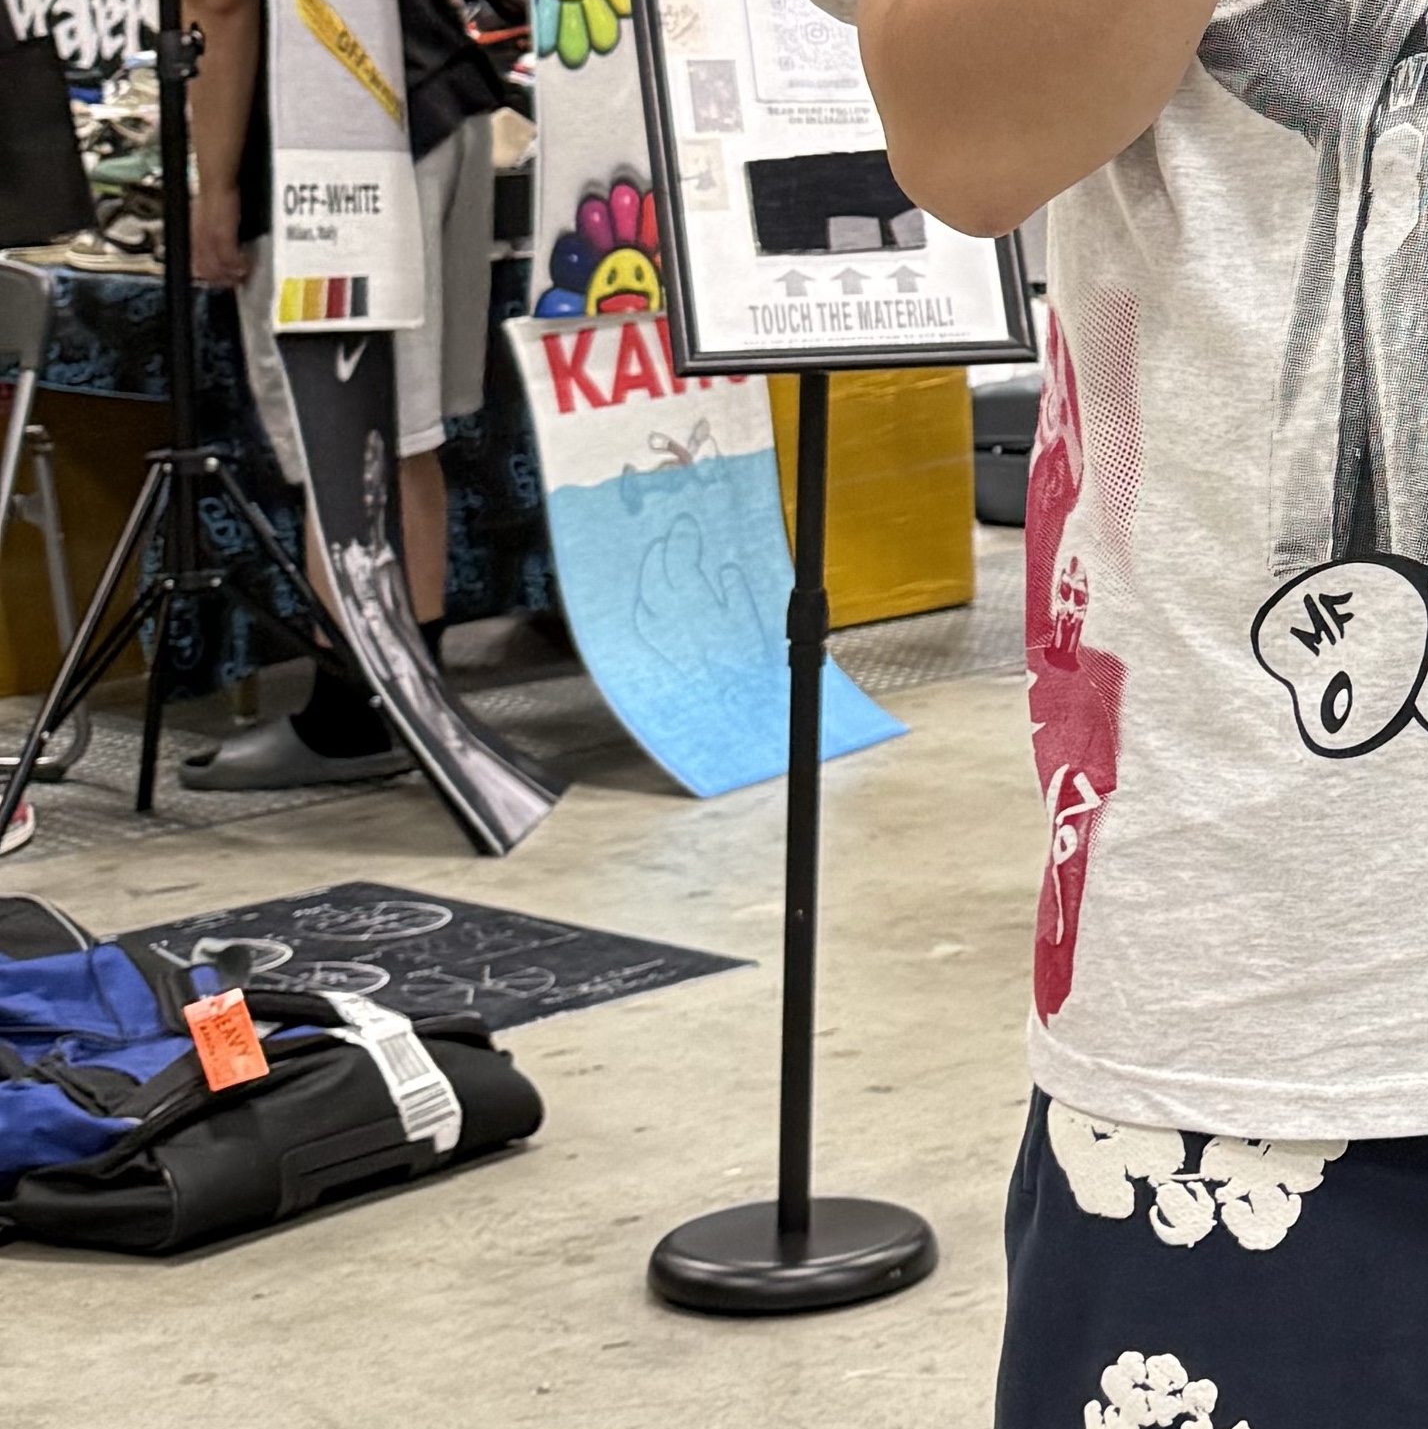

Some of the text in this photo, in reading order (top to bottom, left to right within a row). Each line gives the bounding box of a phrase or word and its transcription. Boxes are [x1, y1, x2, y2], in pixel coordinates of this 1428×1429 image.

[283, 182, 382, 216] OFF-WHITE
[748, 295, 955, 336] TOUCH THE MATERIAL!
[541, 310, 748, 415] KA
[1290, 589, 1354, 657] MF
